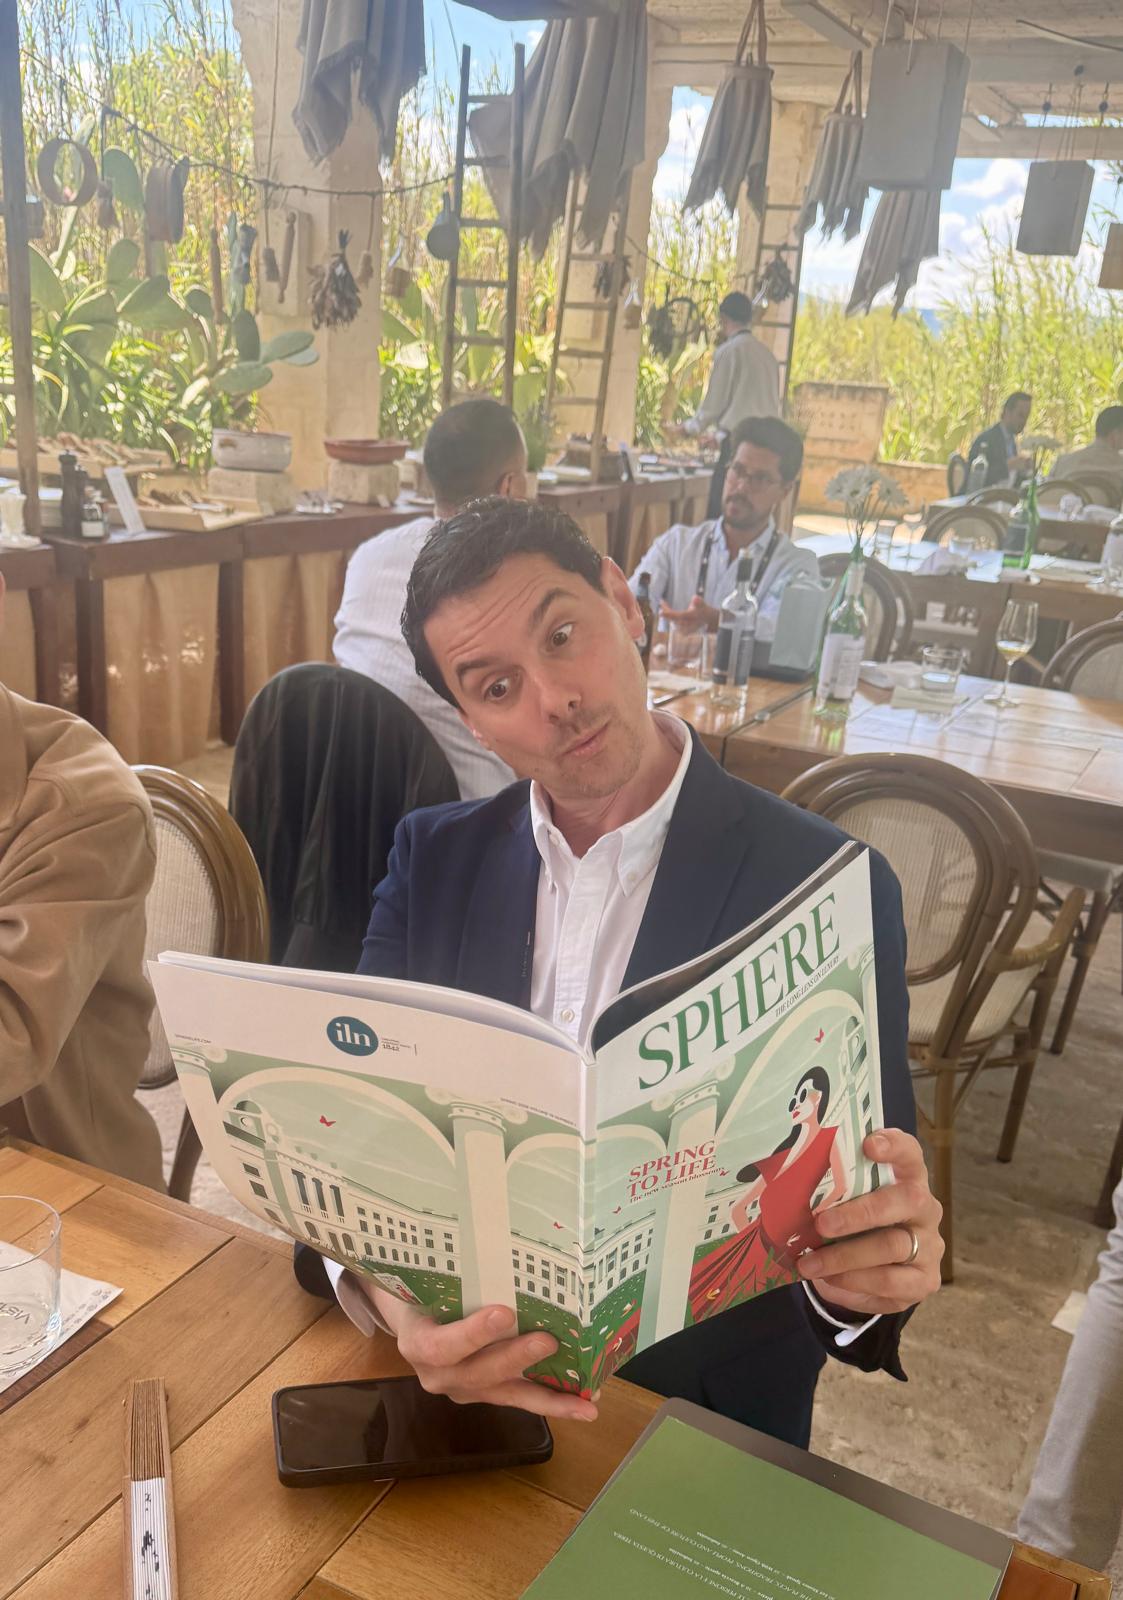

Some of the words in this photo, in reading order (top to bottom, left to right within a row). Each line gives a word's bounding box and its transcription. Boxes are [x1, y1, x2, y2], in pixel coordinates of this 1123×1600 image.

[638, 891, 840, 1090] SPHERE
[336, 1022, 371, 1047] iln
[626, 1175, 659, 1198] TO
[665, 1155, 717, 1183] LIFE
[629, 1140, 715, 1183] SPRING
[630, 1193, 642, 1204] The
[0, 1302, 31, 1325] VIST
